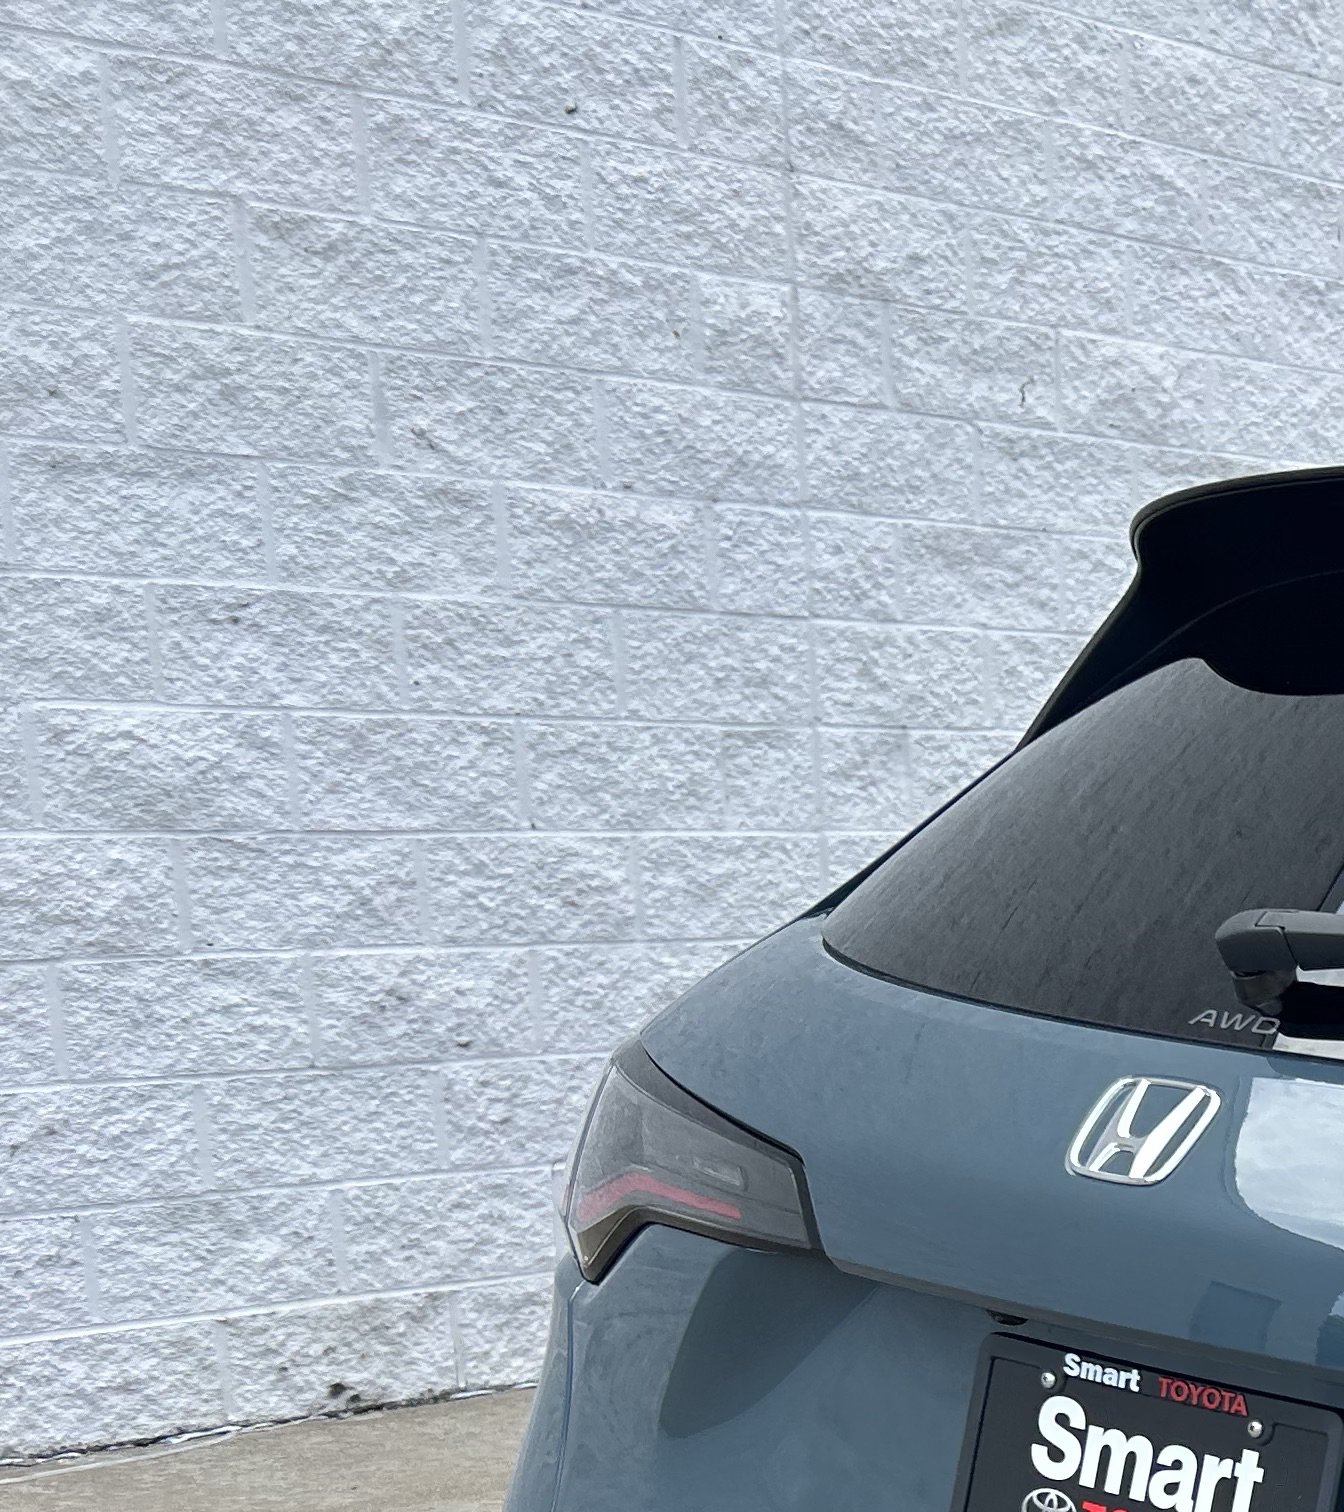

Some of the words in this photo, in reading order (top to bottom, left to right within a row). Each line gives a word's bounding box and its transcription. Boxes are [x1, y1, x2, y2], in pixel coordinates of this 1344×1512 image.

[1187, 1009, 1281, 1035] AWD
[1062, 1352, 1141, 1393] Smart
[1158, 1376, 1248, 1416] TOYOTA
